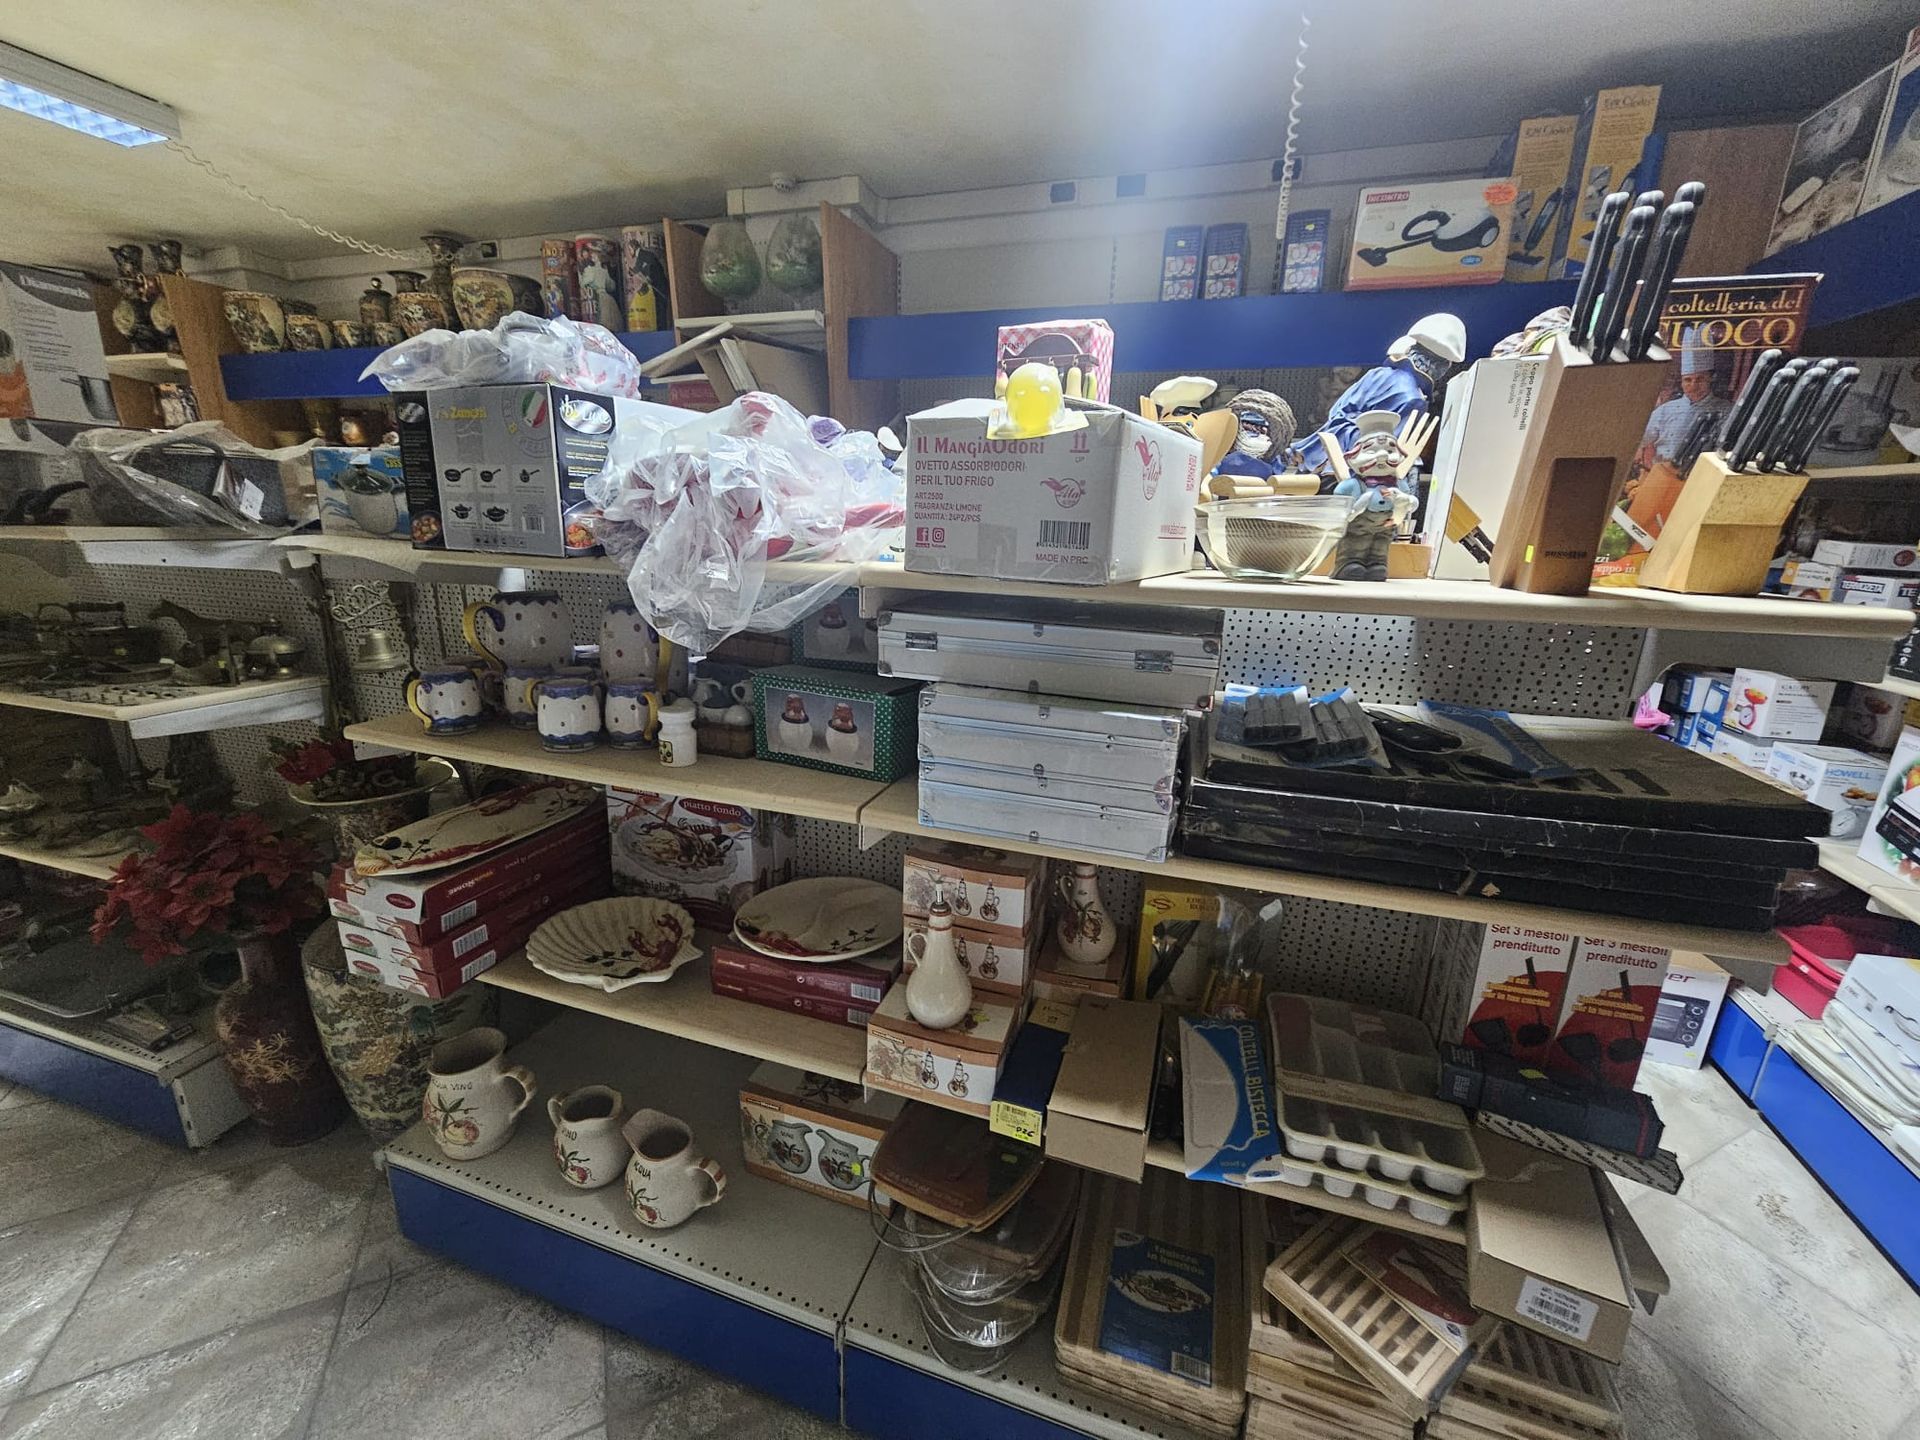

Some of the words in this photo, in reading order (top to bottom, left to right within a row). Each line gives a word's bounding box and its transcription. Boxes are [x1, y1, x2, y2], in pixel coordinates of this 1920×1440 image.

[915, 460, 948, 471] OVETTO
[951, 460, 1025, 472] ASSORBIODORI
[915, 475, 933, 486] PER
[945, 475, 963, 486] TUO
[965, 476, 994, 486] FRIGO
[1035, 554, 1058, 563] MADE
[1825, 769, 1871, 780] HOWELL
[683, 801, 711, 813] piatto
[713, 804, 741, 817] fondo
[1491, 924, 1510, 934] Set
[1493, 939, 1560, 955] prenditutto
[1586, 951, 1658, 969] prenditutto
[1248, 1077, 1271, 1138] BISTECCA
